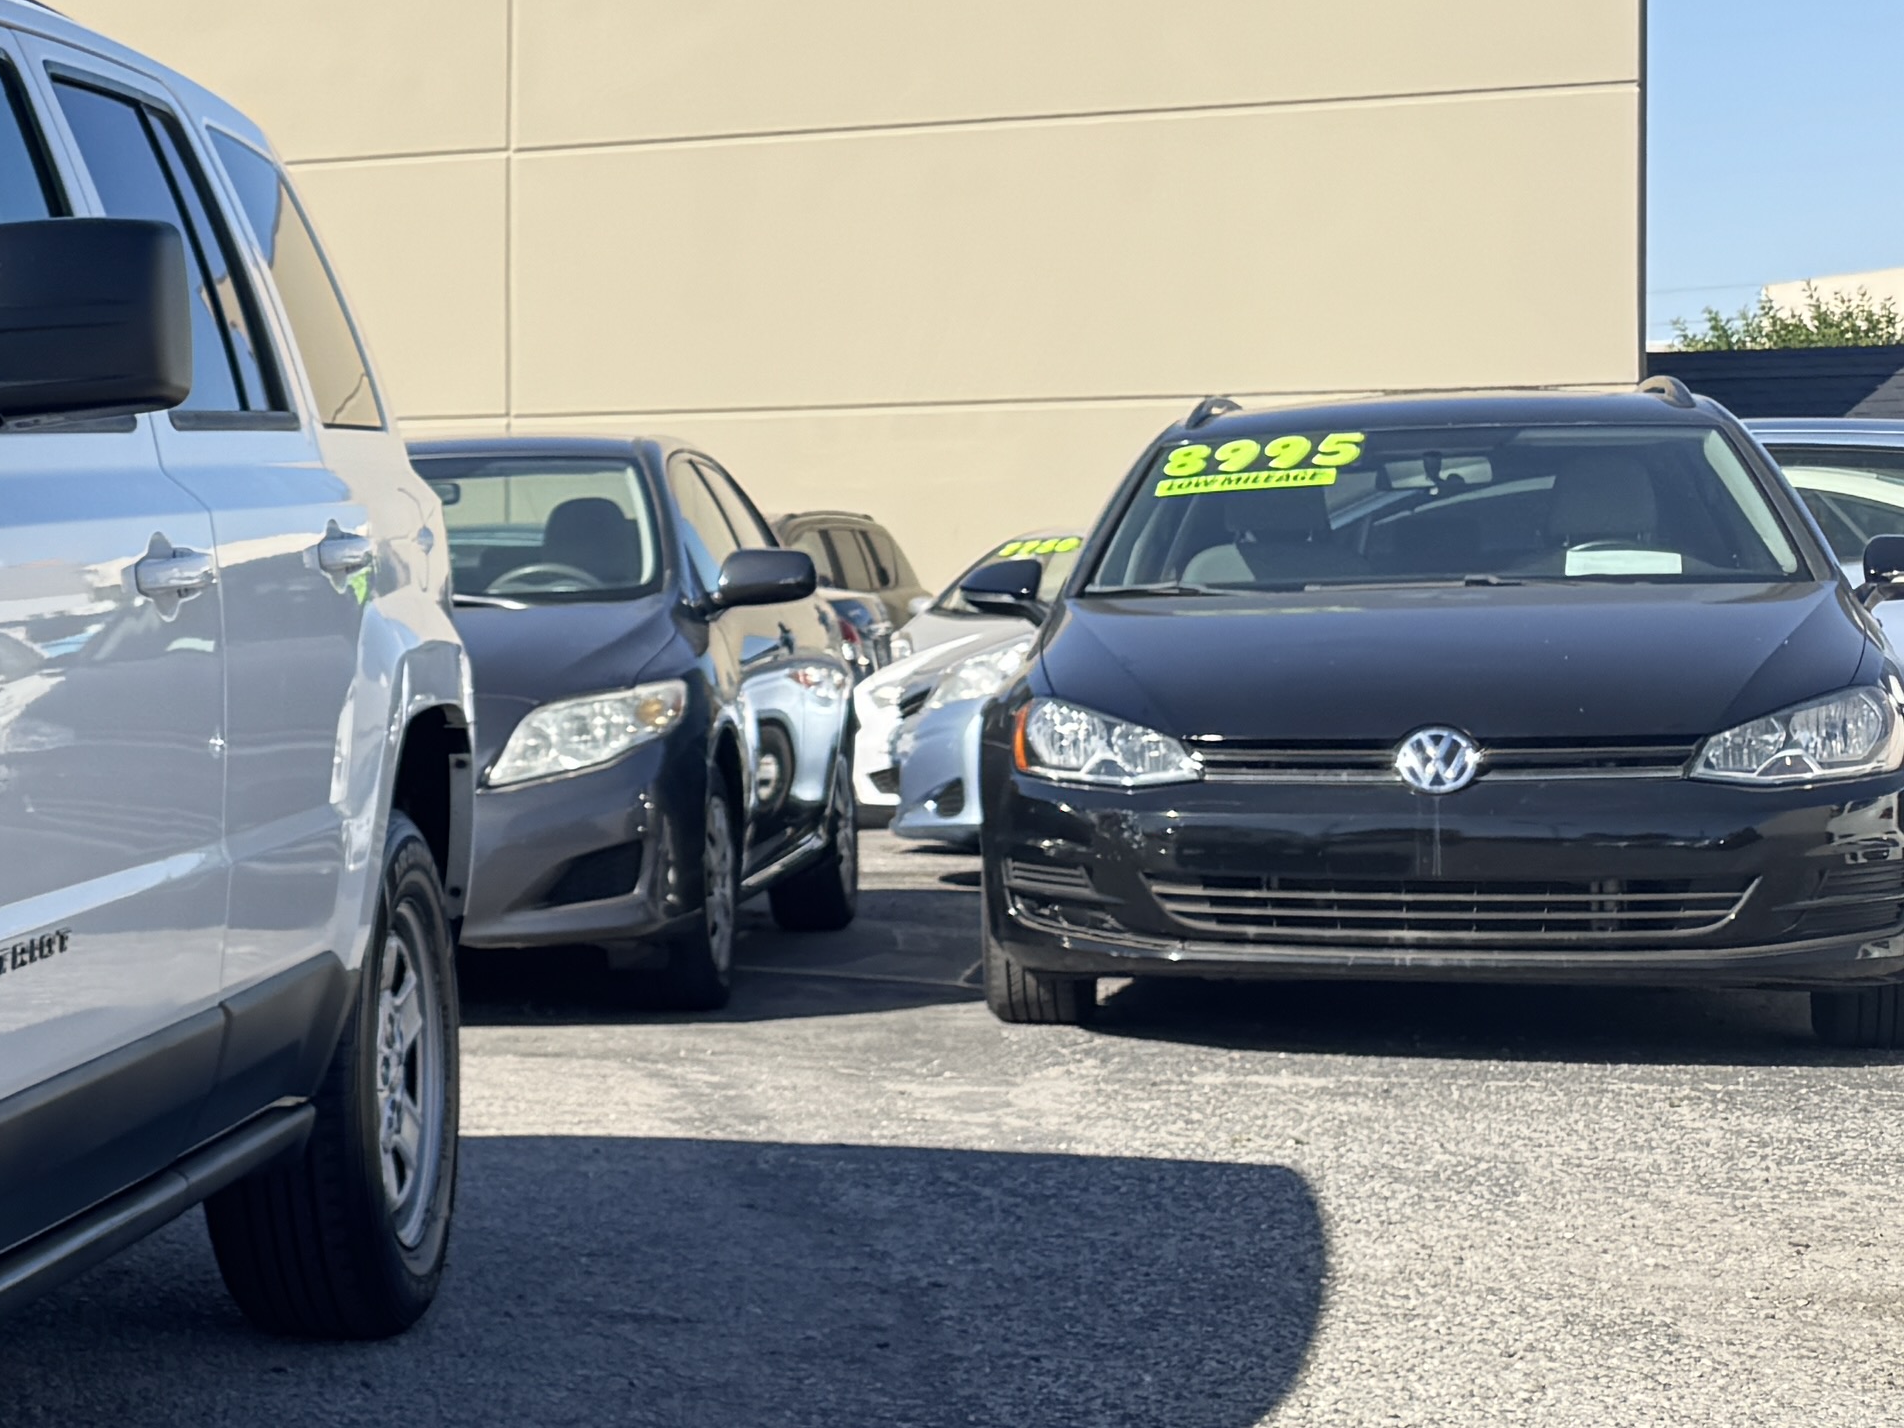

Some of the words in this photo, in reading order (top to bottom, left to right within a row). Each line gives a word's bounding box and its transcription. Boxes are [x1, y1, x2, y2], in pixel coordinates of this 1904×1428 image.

[1163, 432, 1366, 477] 8995
[1167, 478, 1217, 492] LOW
[1221, 470, 1323, 487] MILEAGE
